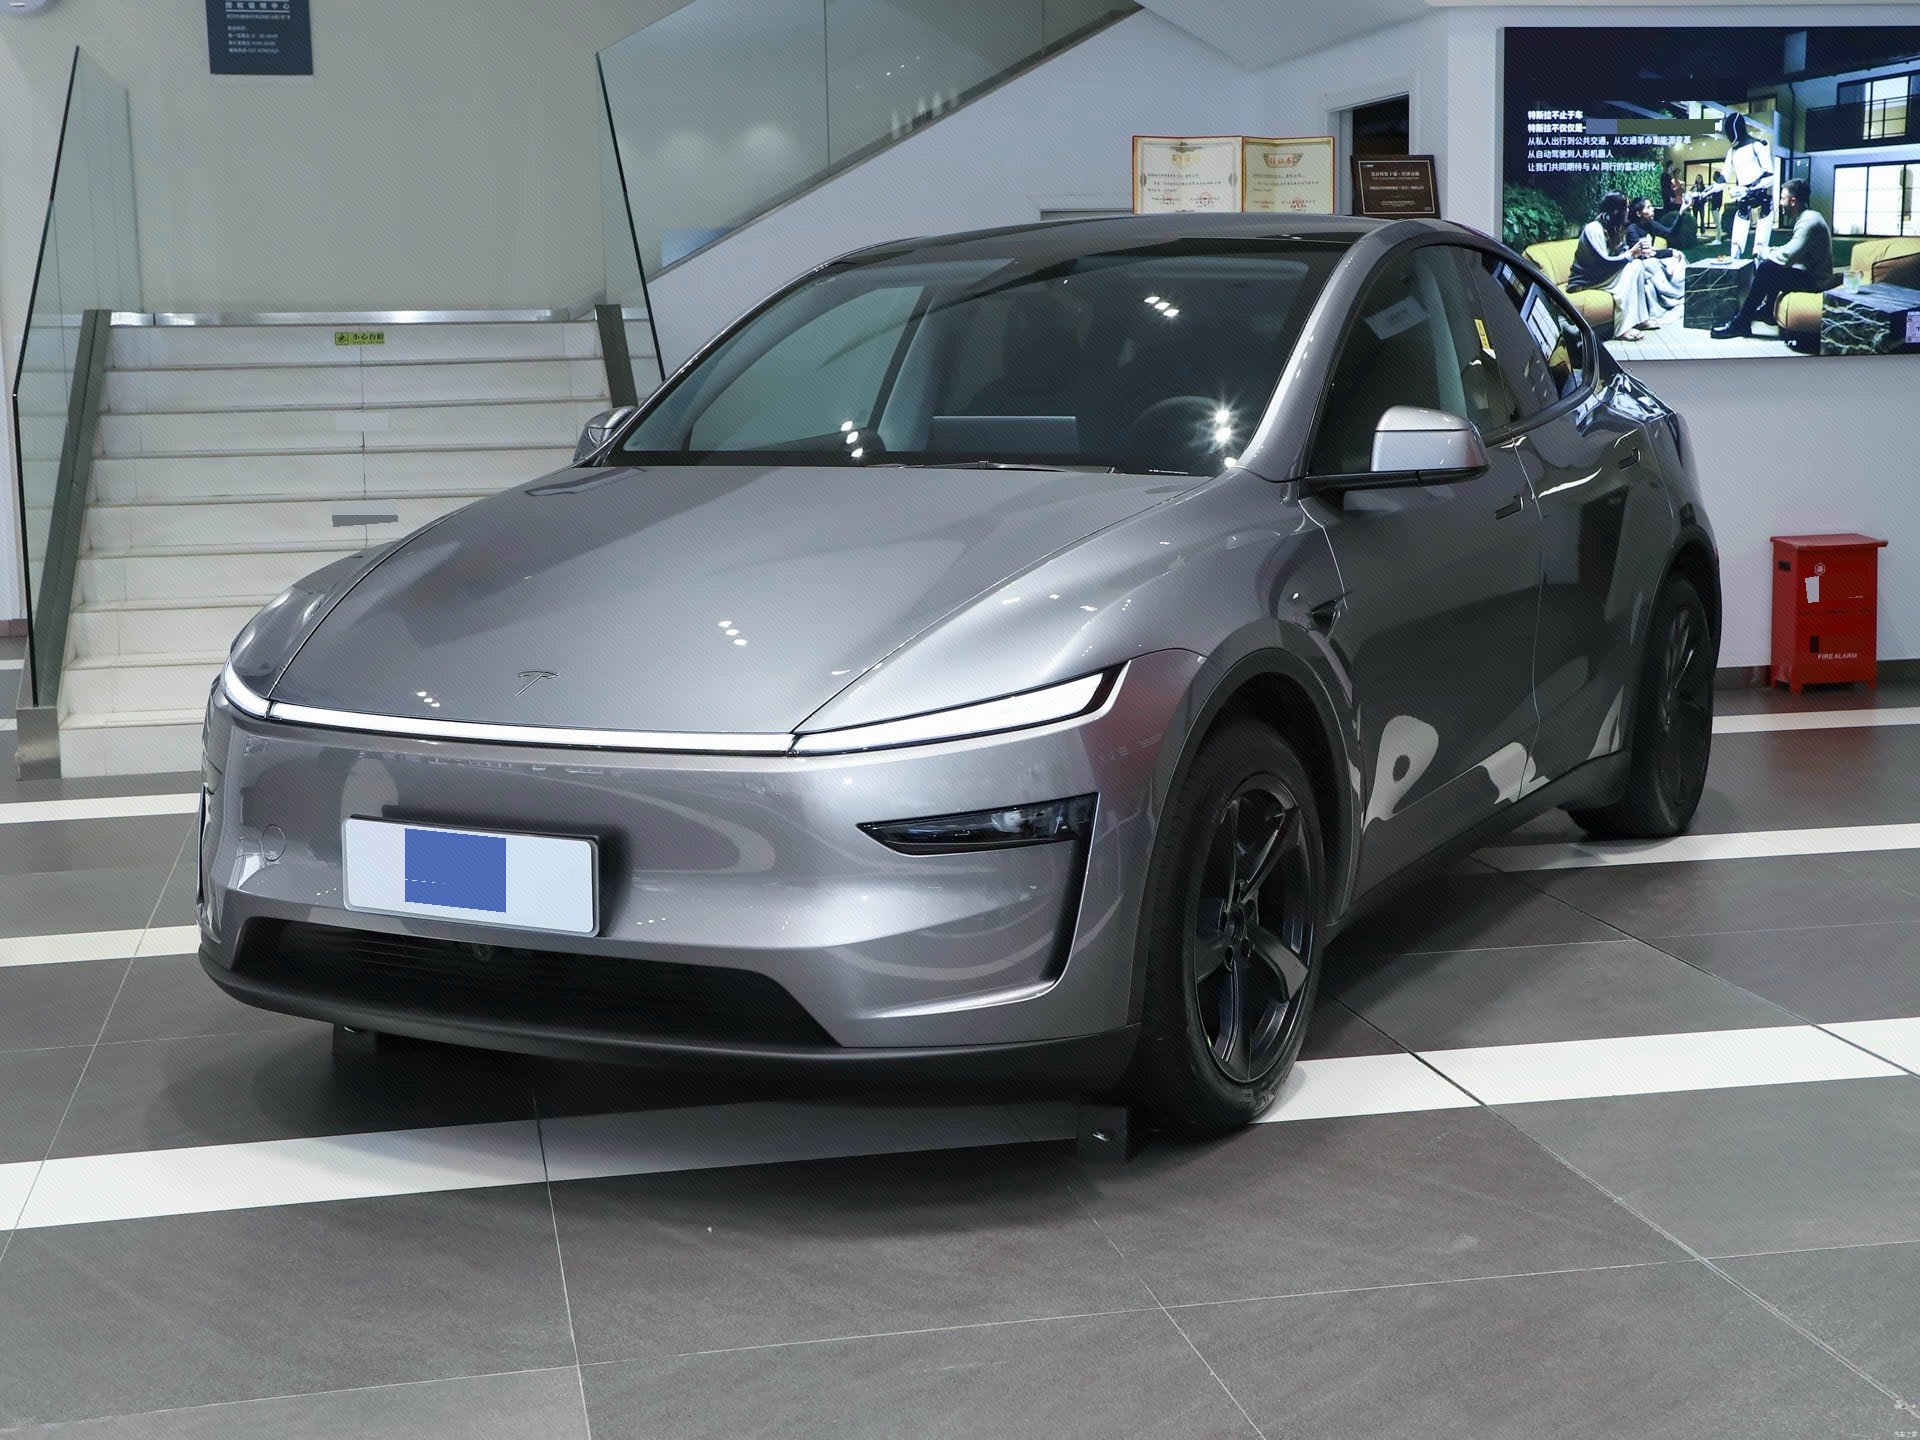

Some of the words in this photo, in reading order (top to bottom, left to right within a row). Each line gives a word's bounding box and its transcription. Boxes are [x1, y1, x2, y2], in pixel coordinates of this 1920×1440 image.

[1527, 110, 1584, 120] 特斯拉不止于车
[1527, 149, 1614, 159] 从自动驾驶到人形机器人
[1527, 162, 1590, 172] 让我们共同期待与
[1591, 163, 1600, 171] AI
[1834, 652, 1857, 660] ALARM
